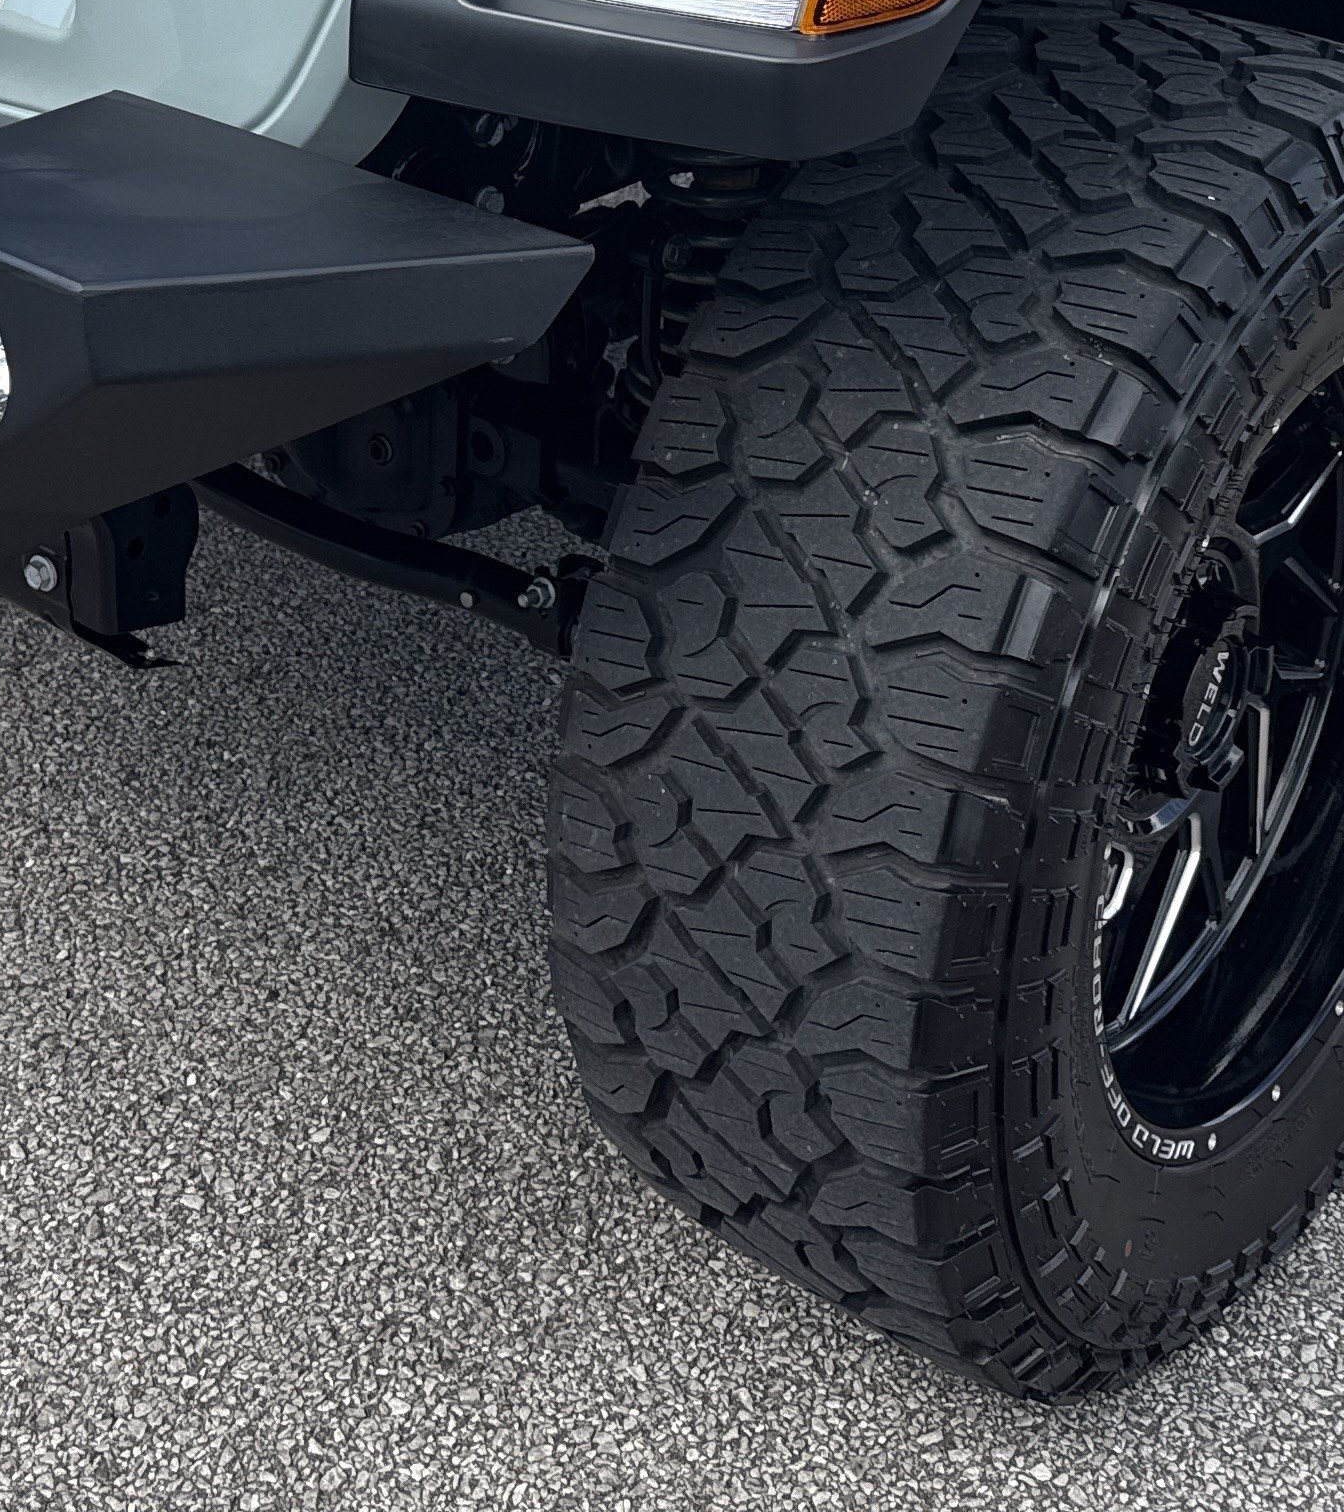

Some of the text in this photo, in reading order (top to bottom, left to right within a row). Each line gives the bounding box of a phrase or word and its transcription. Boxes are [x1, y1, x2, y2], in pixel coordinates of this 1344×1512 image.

[1188, 651, 1230, 747] WELD
[1091, 894, 1195, 1161] WELD OFF-ROAD
